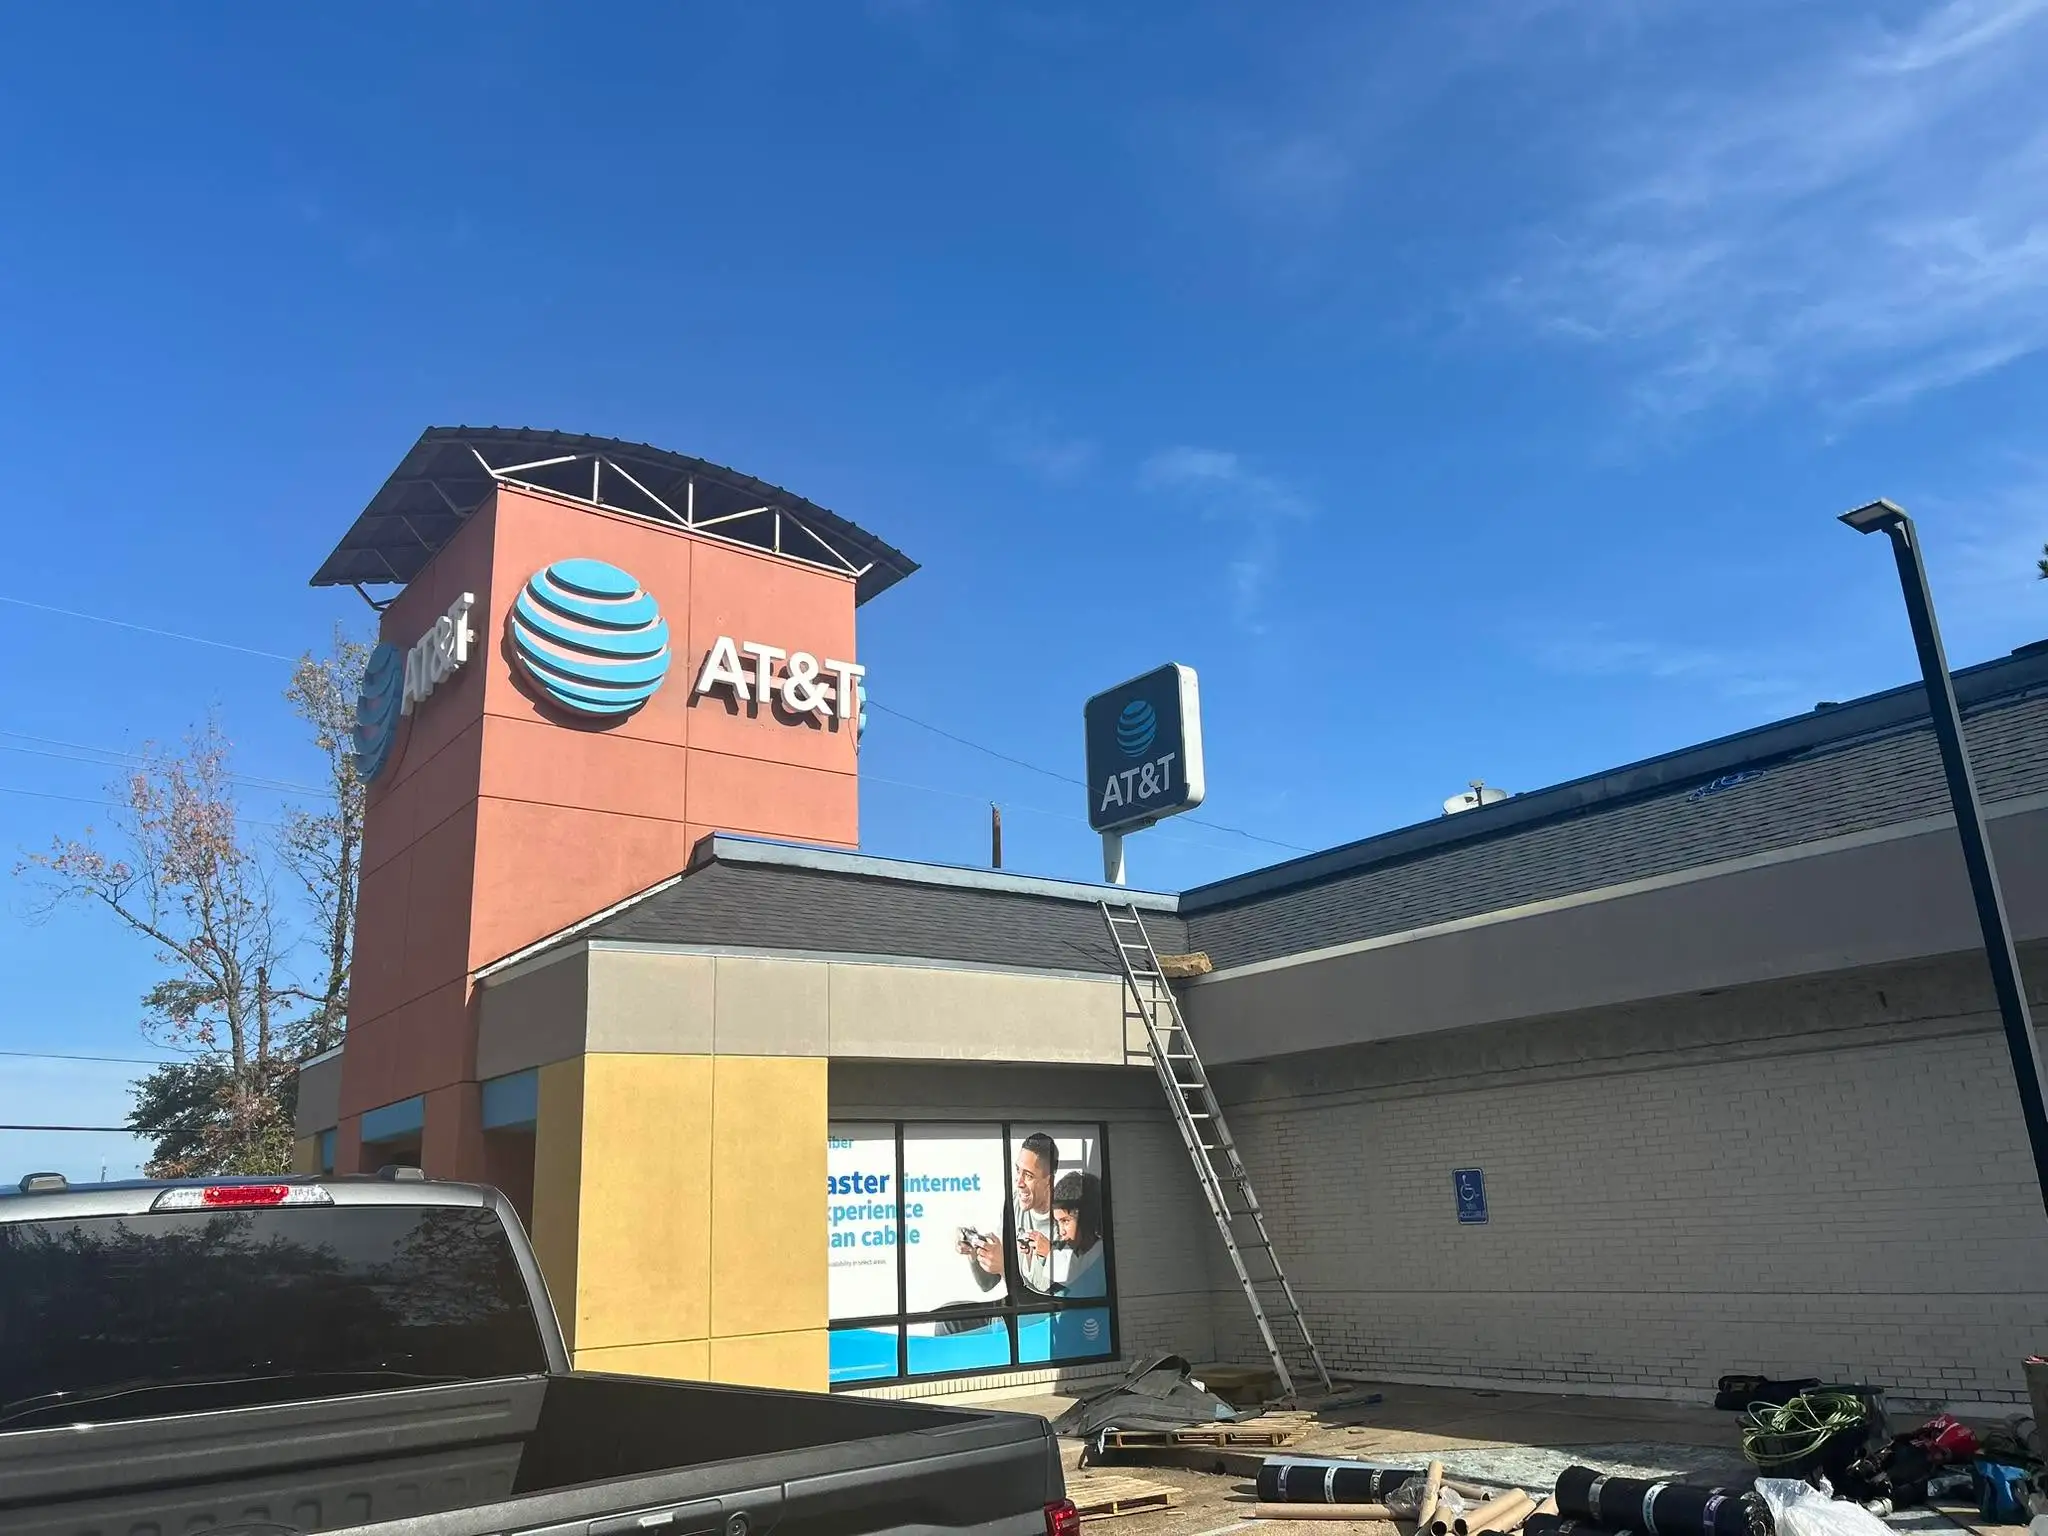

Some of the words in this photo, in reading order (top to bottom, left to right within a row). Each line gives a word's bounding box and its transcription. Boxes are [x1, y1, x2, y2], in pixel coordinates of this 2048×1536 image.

[401, 592, 474, 716] AT&T
[697, 635, 866, 719] AT&T
[1101, 752, 1175, 812] AT&T
[904, 1172, 982, 1193] internet
[828, 1231, 856, 1248] an
[861, 1223, 921, 1246] cable
